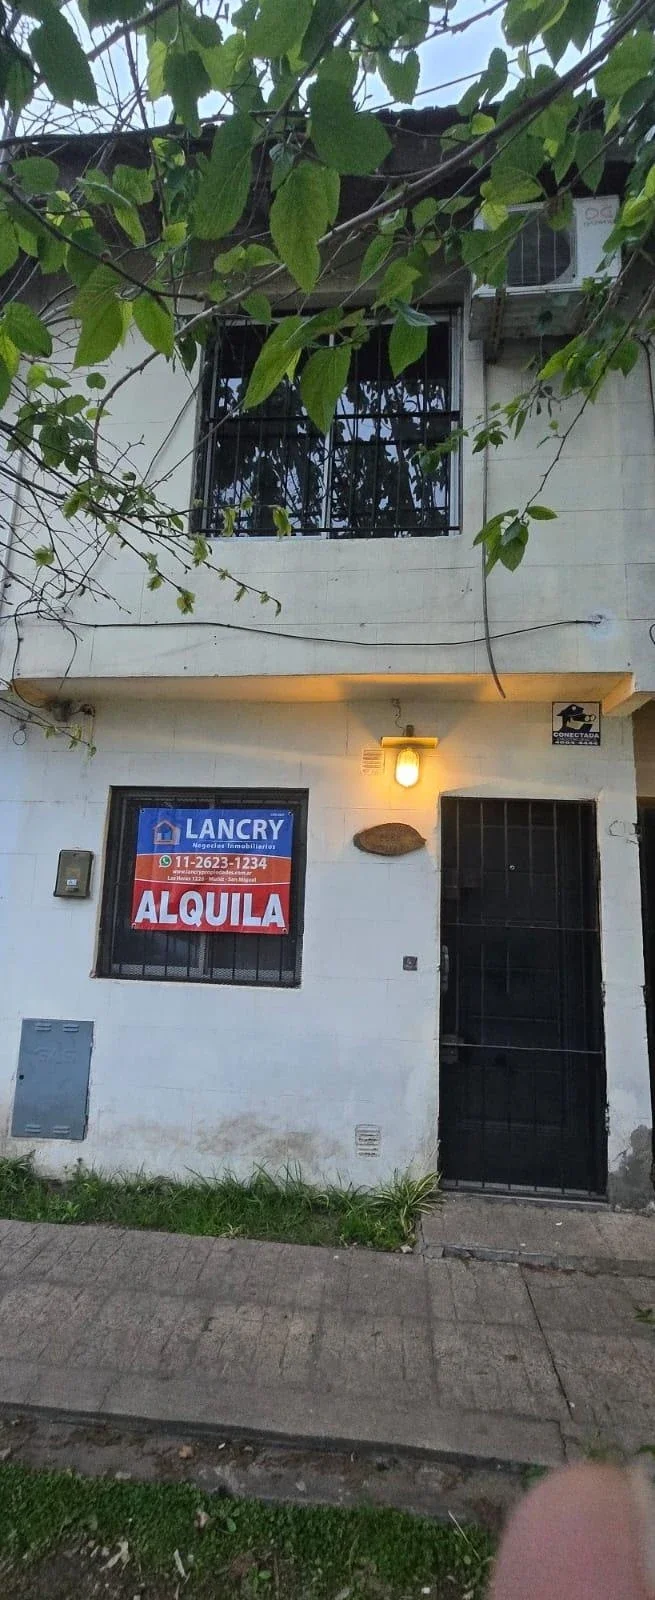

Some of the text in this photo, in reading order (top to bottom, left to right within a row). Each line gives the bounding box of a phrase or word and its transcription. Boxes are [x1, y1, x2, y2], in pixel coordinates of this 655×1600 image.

[186, 818, 284, 840] LANCRY
[192, 842, 276, 850] Negocios Inmobiliarios
[175, 855, 267, 870] 11-2623-1234
[134, 890, 286, 927] ALQUILA
